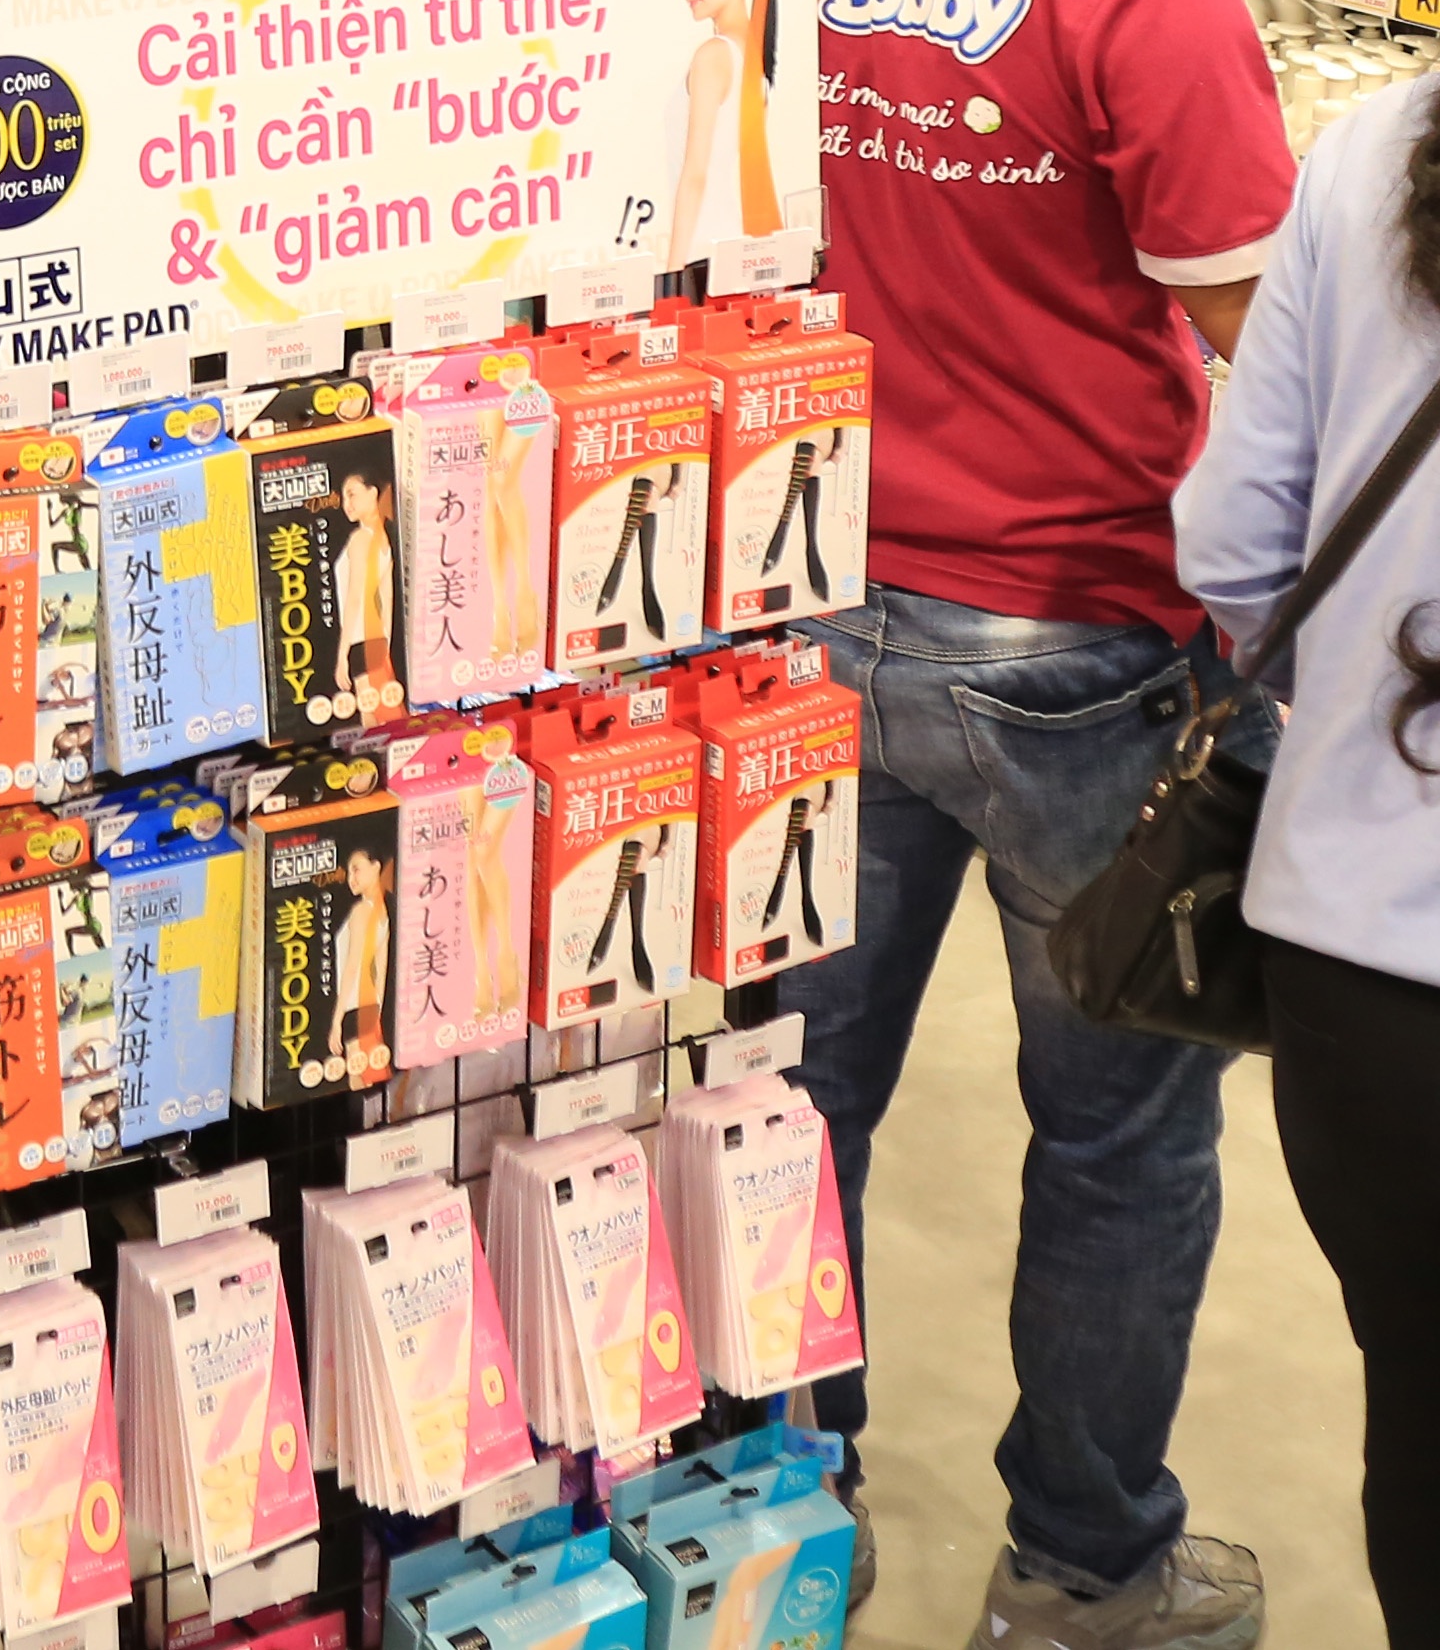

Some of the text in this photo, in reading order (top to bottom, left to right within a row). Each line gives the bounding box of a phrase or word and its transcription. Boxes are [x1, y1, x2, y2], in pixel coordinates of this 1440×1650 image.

[137, 10, 237, 87] Cải
[2, 72, 52, 97] CỘNG
[47, 113, 83, 133] triệu
[138, 101, 238, 190] chỉ
[256, 86, 375, 171] cần
[53, 134, 80, 153] set
[31, 173, 67, 197] BÁN
[979, 151, 1066, 186] sinh
[613, 194, 656, 249] !?
[165, 217, 219, 286] &
[11, 316, 116, 367] MAKE
[736, 382, 808, 433] 着圧
[432, 441, 490, 465] 大山式
[571, 417, 646, 468] 着圧
[735, 429, 779, 447] ソックス
[264, 473, 329, 503] 大山式
[571, 465, 615, 482] ソックス
[116, 499, 180, 529] 大山式
[429, 488, 467, 657] あし美人
[268, 522, 315, 705] 美BODY
[121, 549, 174, 732] 外反母趾
[736, 742, 802, 795] 着圧
[413, 815, 471, 841] 大山式
[563, 786, 636, 836] 着圧
[560, 830, 606, 850] ソックス
[273, 850, 337, 879] 大山式
[121, 895, 182, 923] 大山式
[413, 865, 450, 1024] あし美人
[273, 895, 316, 1071] 美BODY
[731, 1155, 817, 1192] ウオノメパッド
[194, 1193, 234, 1211] 112.000
[566, 1206, 645, 1246] ウオノメパッド
[7, 1248, 48, 1266] 112.000
[380, 1257, 469, 1305] ウオノメパッド
[184, 1315, 272, 1361] ウオノメパッド
[0, 1376, 94, 1416] 外反母趾パッド
